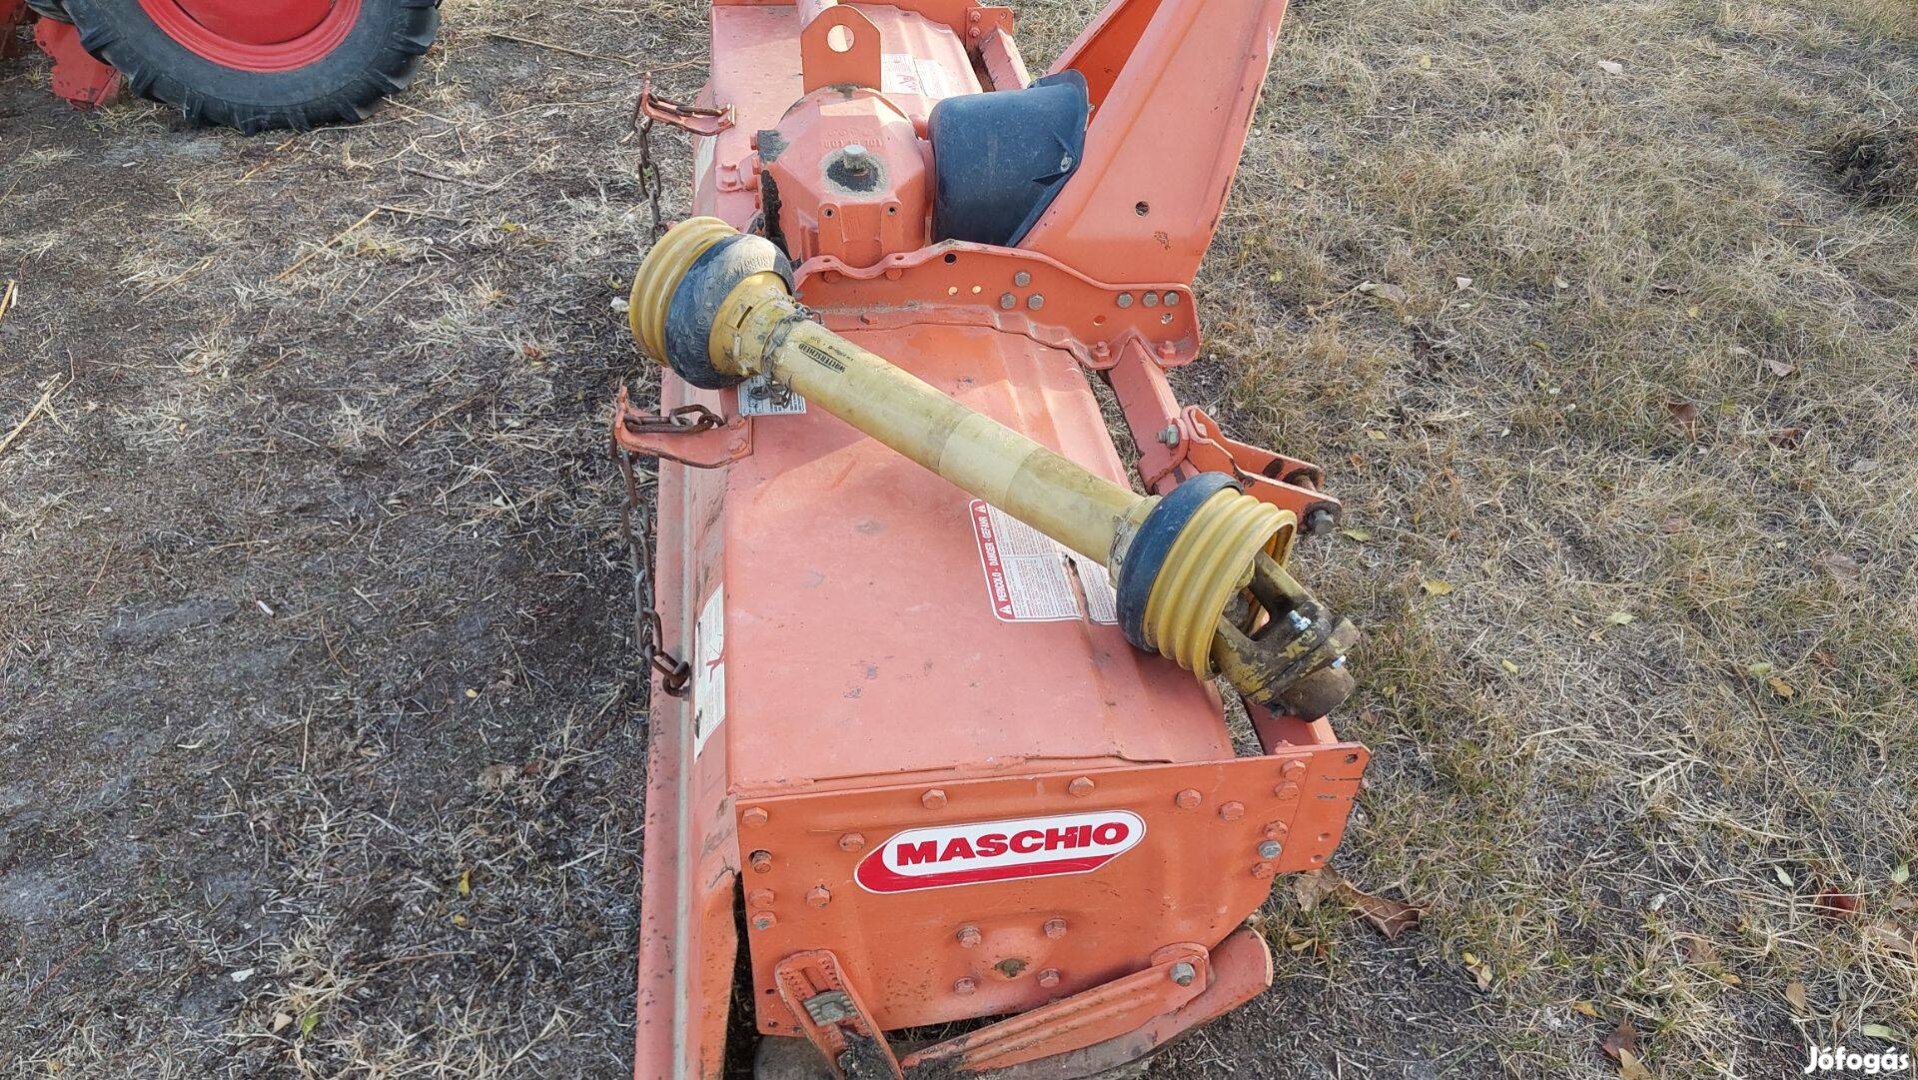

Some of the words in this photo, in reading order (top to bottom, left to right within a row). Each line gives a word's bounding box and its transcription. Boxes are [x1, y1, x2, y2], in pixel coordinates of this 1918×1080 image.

[798, 344, 846, 372] WALTERSCHEID
[984, 542, 999, 567] DANGER
[992, 572, 1008, 601] PERICOLO
[897, 822, 1129, 866] MASCHIO
